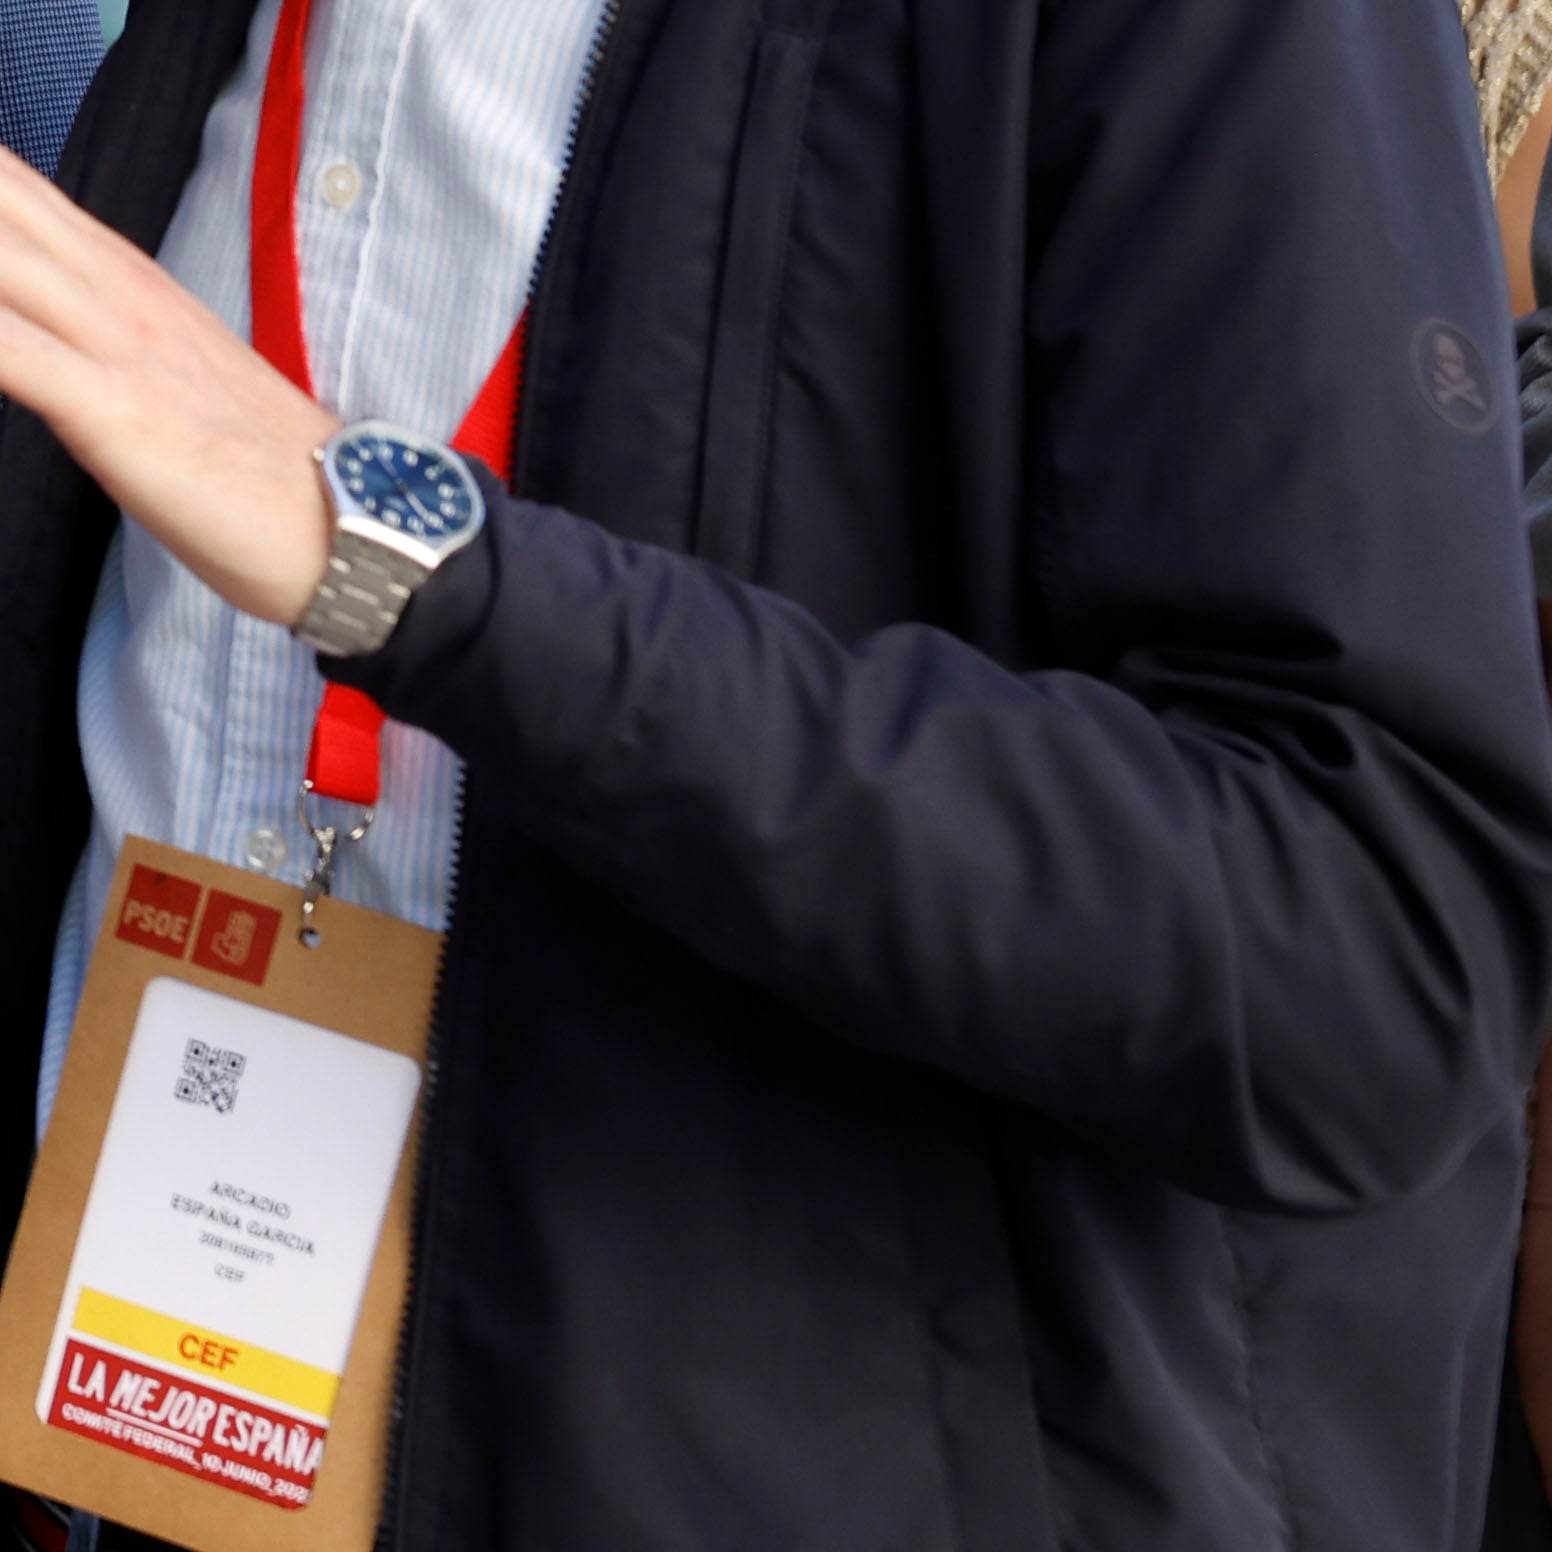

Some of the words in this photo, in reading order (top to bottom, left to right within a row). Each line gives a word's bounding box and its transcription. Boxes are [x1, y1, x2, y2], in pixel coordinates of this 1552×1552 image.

[123, 898, 190, 944] PSOE
[209, 1179, 291, 1221] ARCADIO
[178, 1331, 239, 1374] CEF
[67, 1351, 107, 1403] LA
[108, 1368, 217, 1439] MEJOR
[211, 1401, 325, 1476] ESPAÑA
